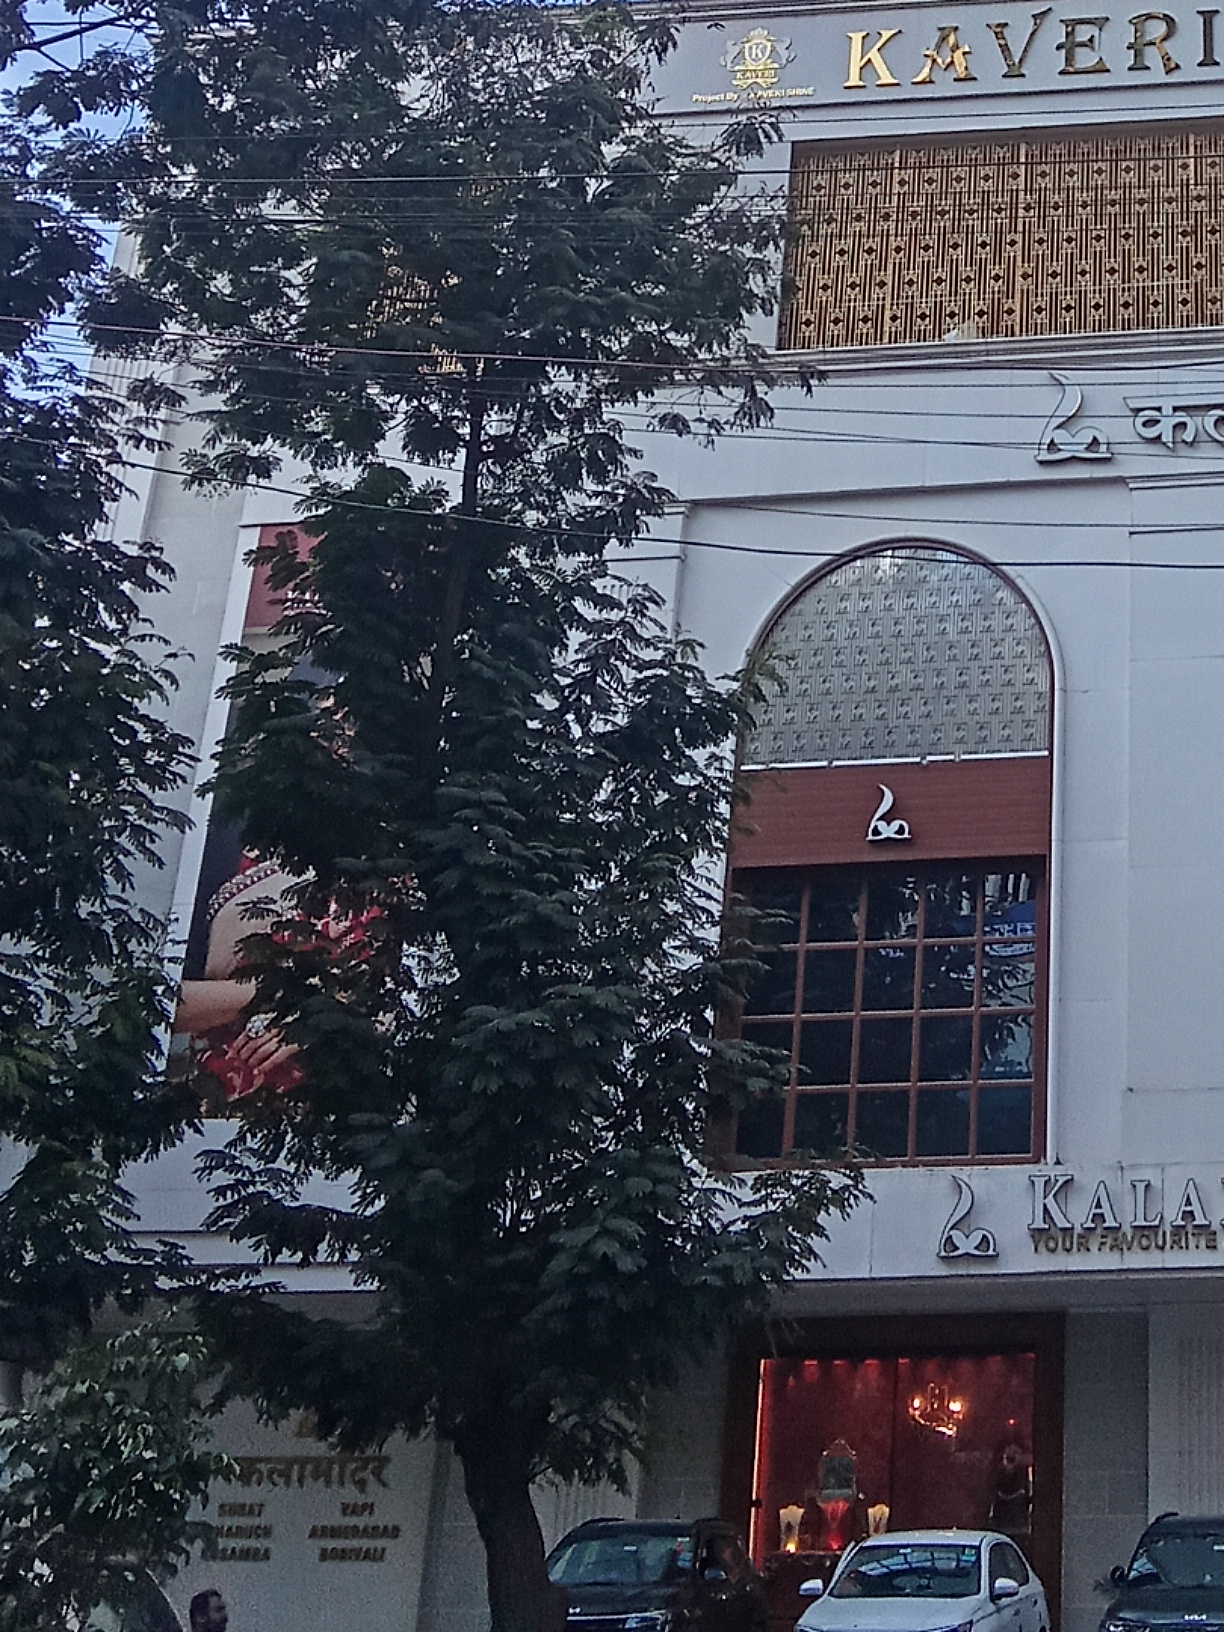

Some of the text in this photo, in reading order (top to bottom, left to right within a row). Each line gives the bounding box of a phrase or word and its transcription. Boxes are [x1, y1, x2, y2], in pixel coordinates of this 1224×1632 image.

[843, 7, 1220, 89] KAVERI
[692, 92, 724, 104] Project
[726, 92, 739, 102] By
[1030, 1231, 1091, 1253] YOUR
[1097, 1229, 1218, 1252] FAVOURITE
